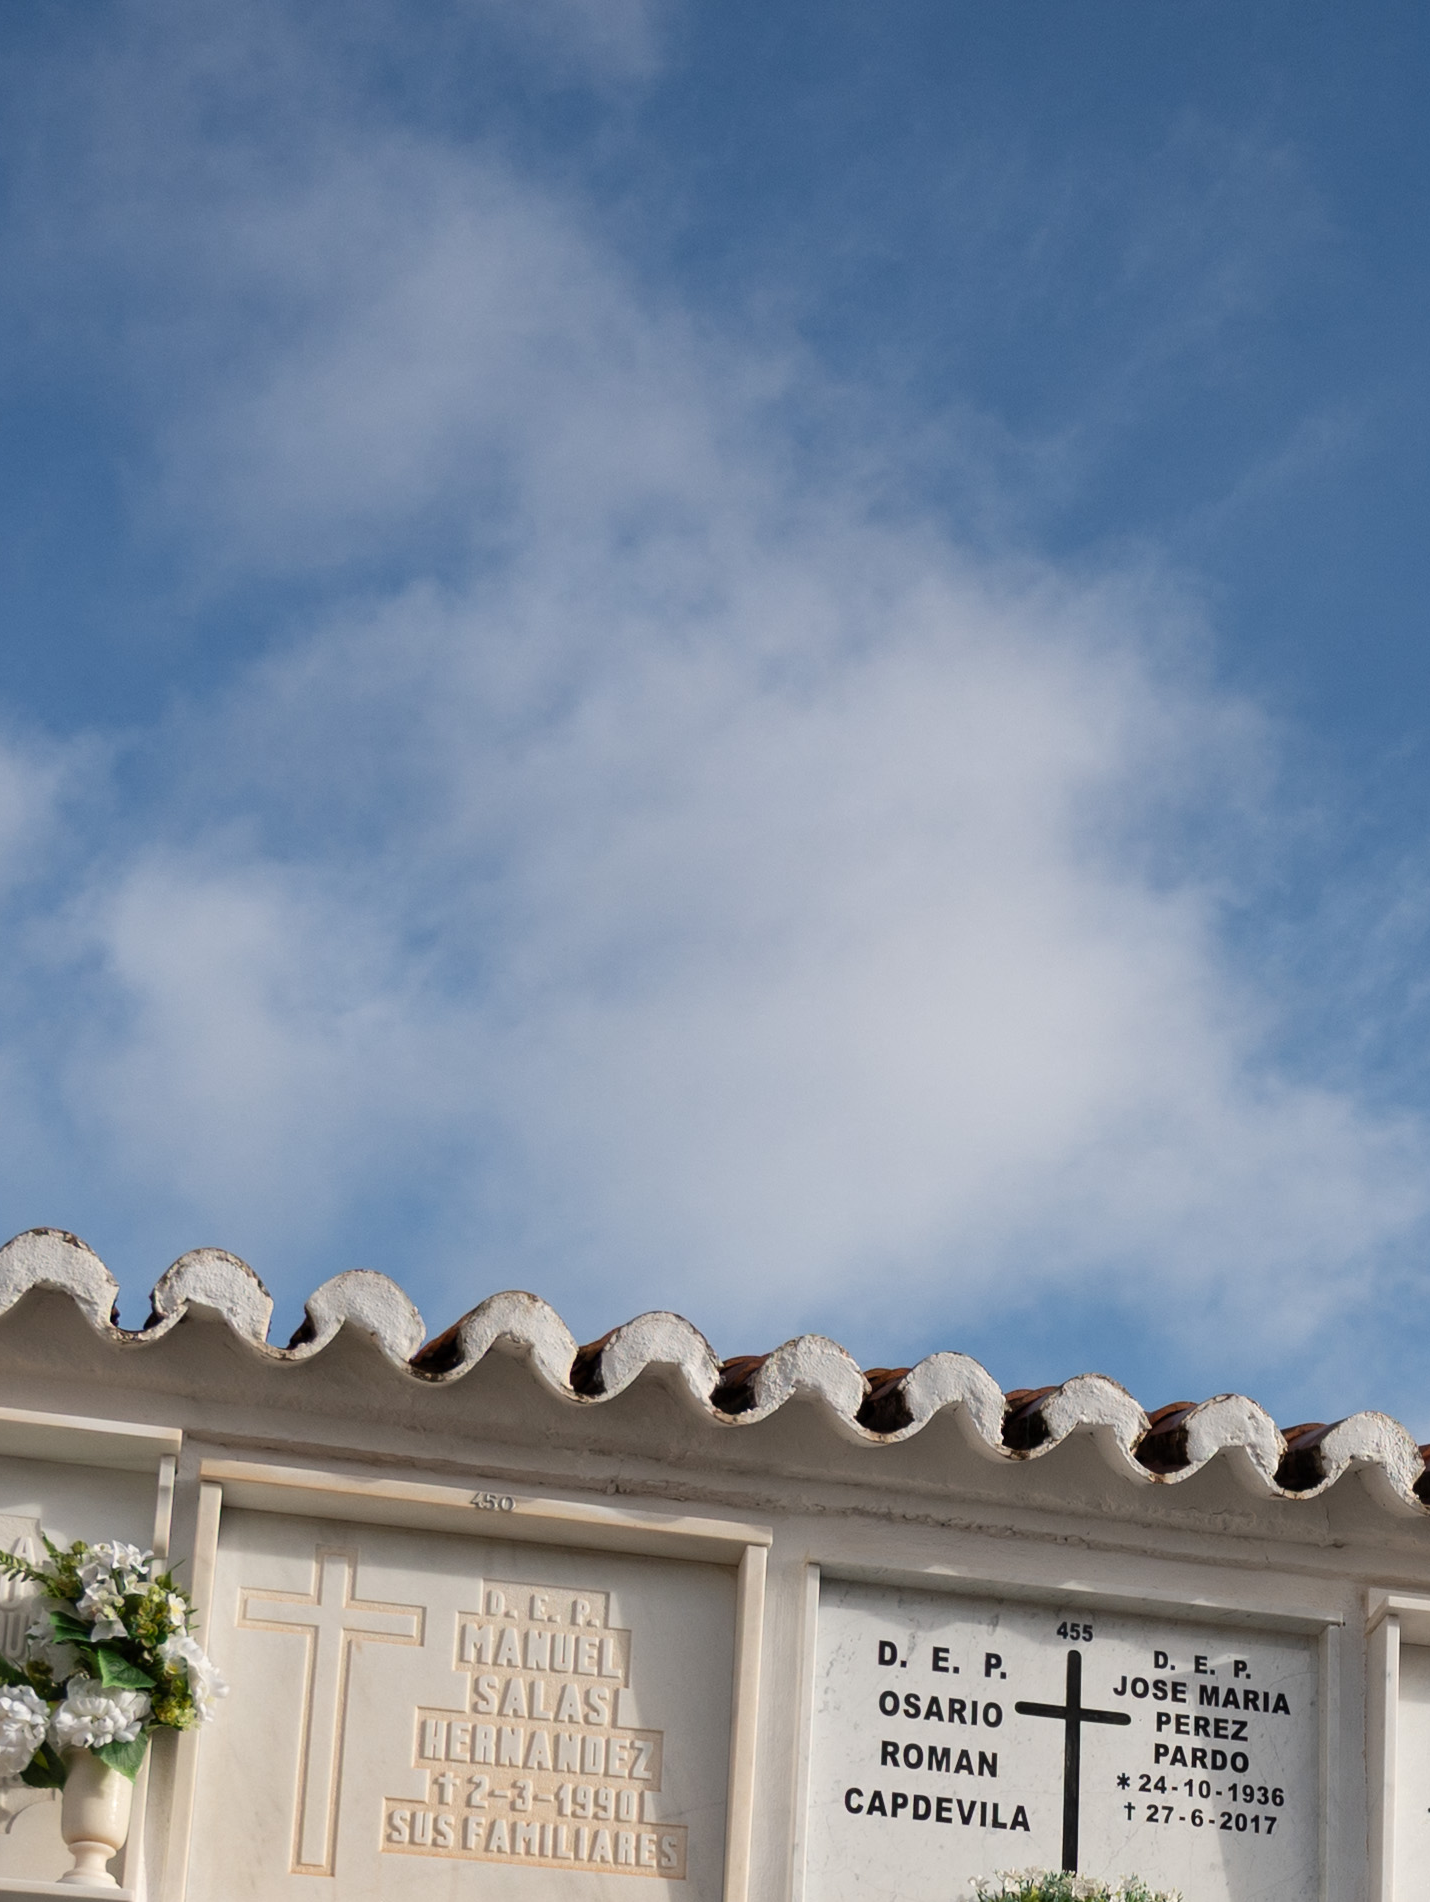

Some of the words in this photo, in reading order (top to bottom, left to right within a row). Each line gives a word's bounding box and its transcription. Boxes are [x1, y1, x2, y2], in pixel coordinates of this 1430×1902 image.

[470, 1492, 516, 1513] 450
[462, 1623, 622, 1680] MANUEL
[1056, 1621, 1094, 1642] 455
[474, 1676, 611, 1726] SALAS
[877, 1690, 1003, 1727] OSARIO
[1113, 1675, 1187, 1703] JOSE
[1199, 1686, 1291, 1716] MARIA
[1155, 1712, 1249, 1742] PEREZ
[423, 1721, 655, 1780] HERNANDEZ
[880, 1740, 998, 1779] ROMAN
[1154, 1743, 1250, 1773] PARDO
[844, 1787, 1031, 1832] CAPDEVILA
[388, 1810, 454, 1846] SUS
[468, 1817, 678, 1868] FAMILIARES
